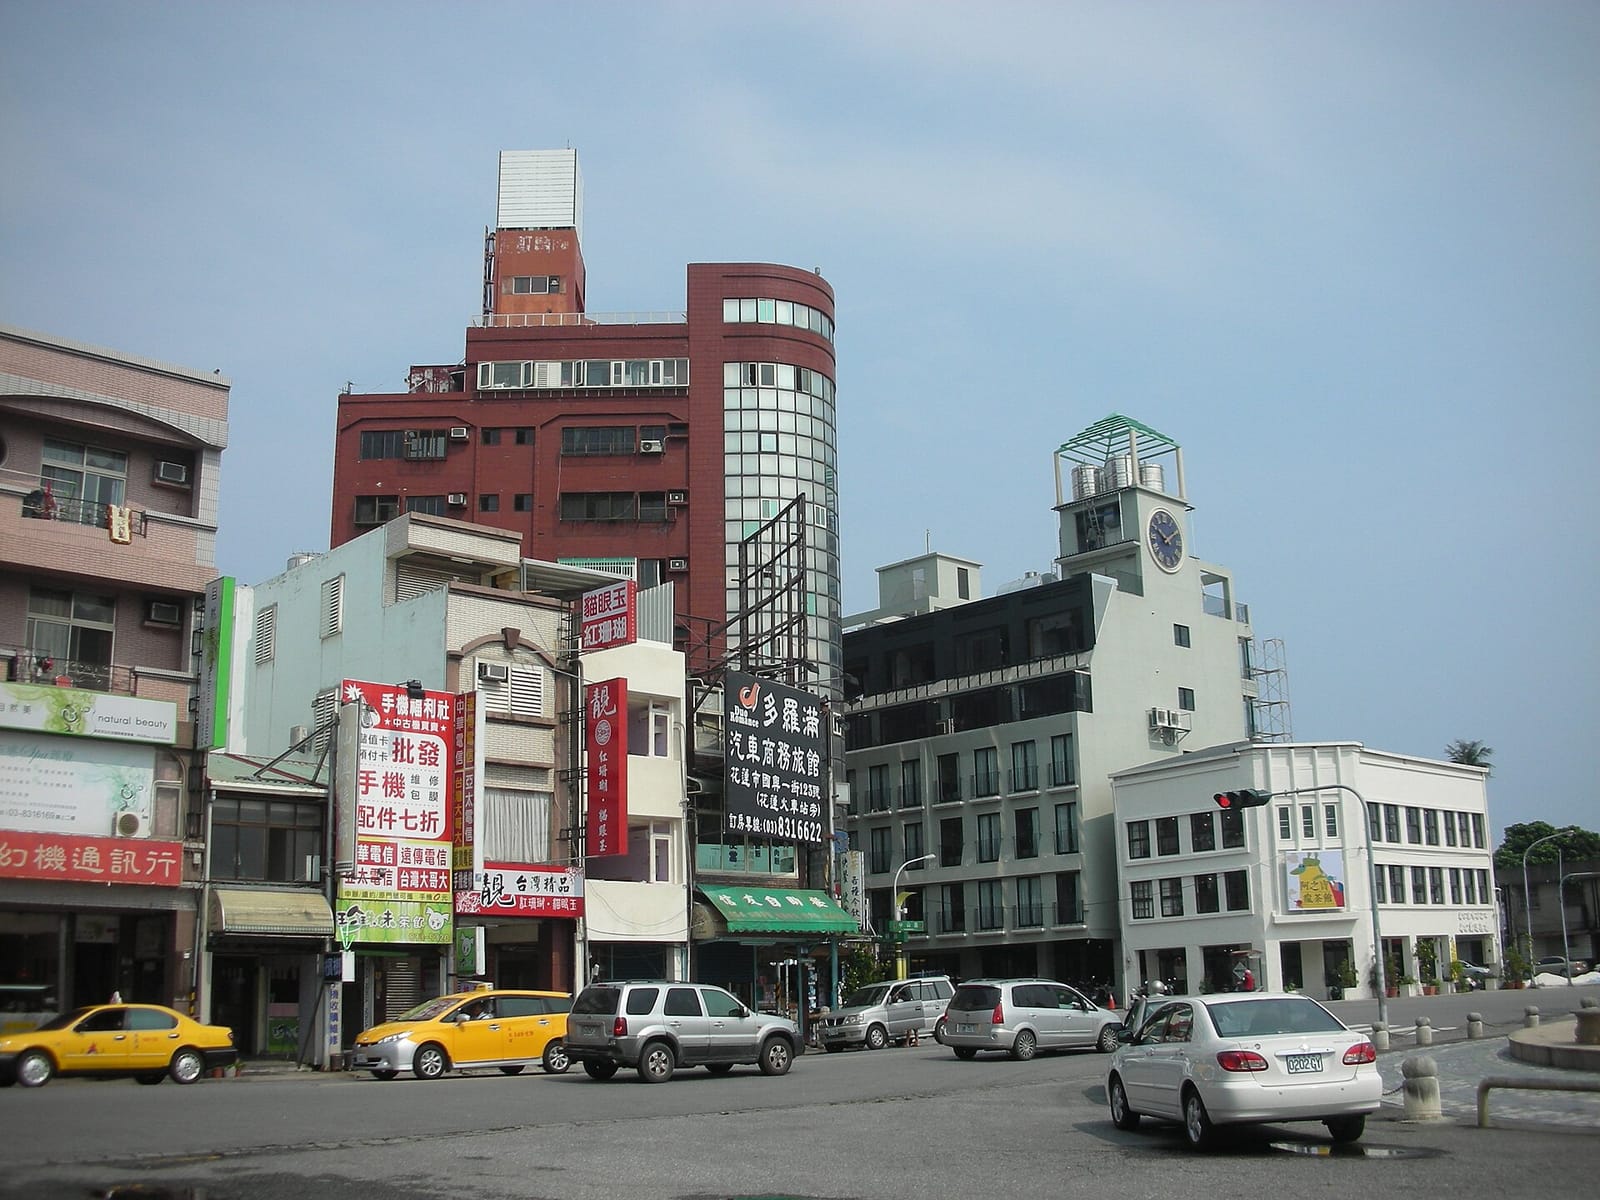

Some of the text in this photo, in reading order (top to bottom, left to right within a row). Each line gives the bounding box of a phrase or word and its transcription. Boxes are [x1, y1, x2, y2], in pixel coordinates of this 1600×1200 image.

[584, 587, 626, 617] 貓眼玉
[584, 616, 627, 647] 紅珊瑚
[381, 693, 449, 720] 手機福利社
[590, 685, 617, 719] 靚
[734, 705, 749, 718] Duo
[763, 692, 820, 738] 多羅滿
[98, 715, 168, 729] natural beauty
[456, 699, 464, 766] 中華電信
[730, 711, 759, 728] Romance
[392, 737, 440, 767] 批發
[729, 730, 820, 777] 汽車商務旅館
[359, 770, 405, 799] 手機
[411, 774, 439, 786] 維修
[730, 766, 820, 800] 花蓮市國興一街123號
[411, 790, 438, 802] 包膜
[465, 774, 473, 842] 亞太電信
[756, 791, 821, 818] (花蓮火車站旁)
[358, 805, 439, 833] 配件七折
[401, 847, 447, 866] 遠傳電信
[400, 870, 448, 889] 台灣大哥大
[481, 873, 515, 906] 靚
[516, 875, 570, 893] 台灣精品
